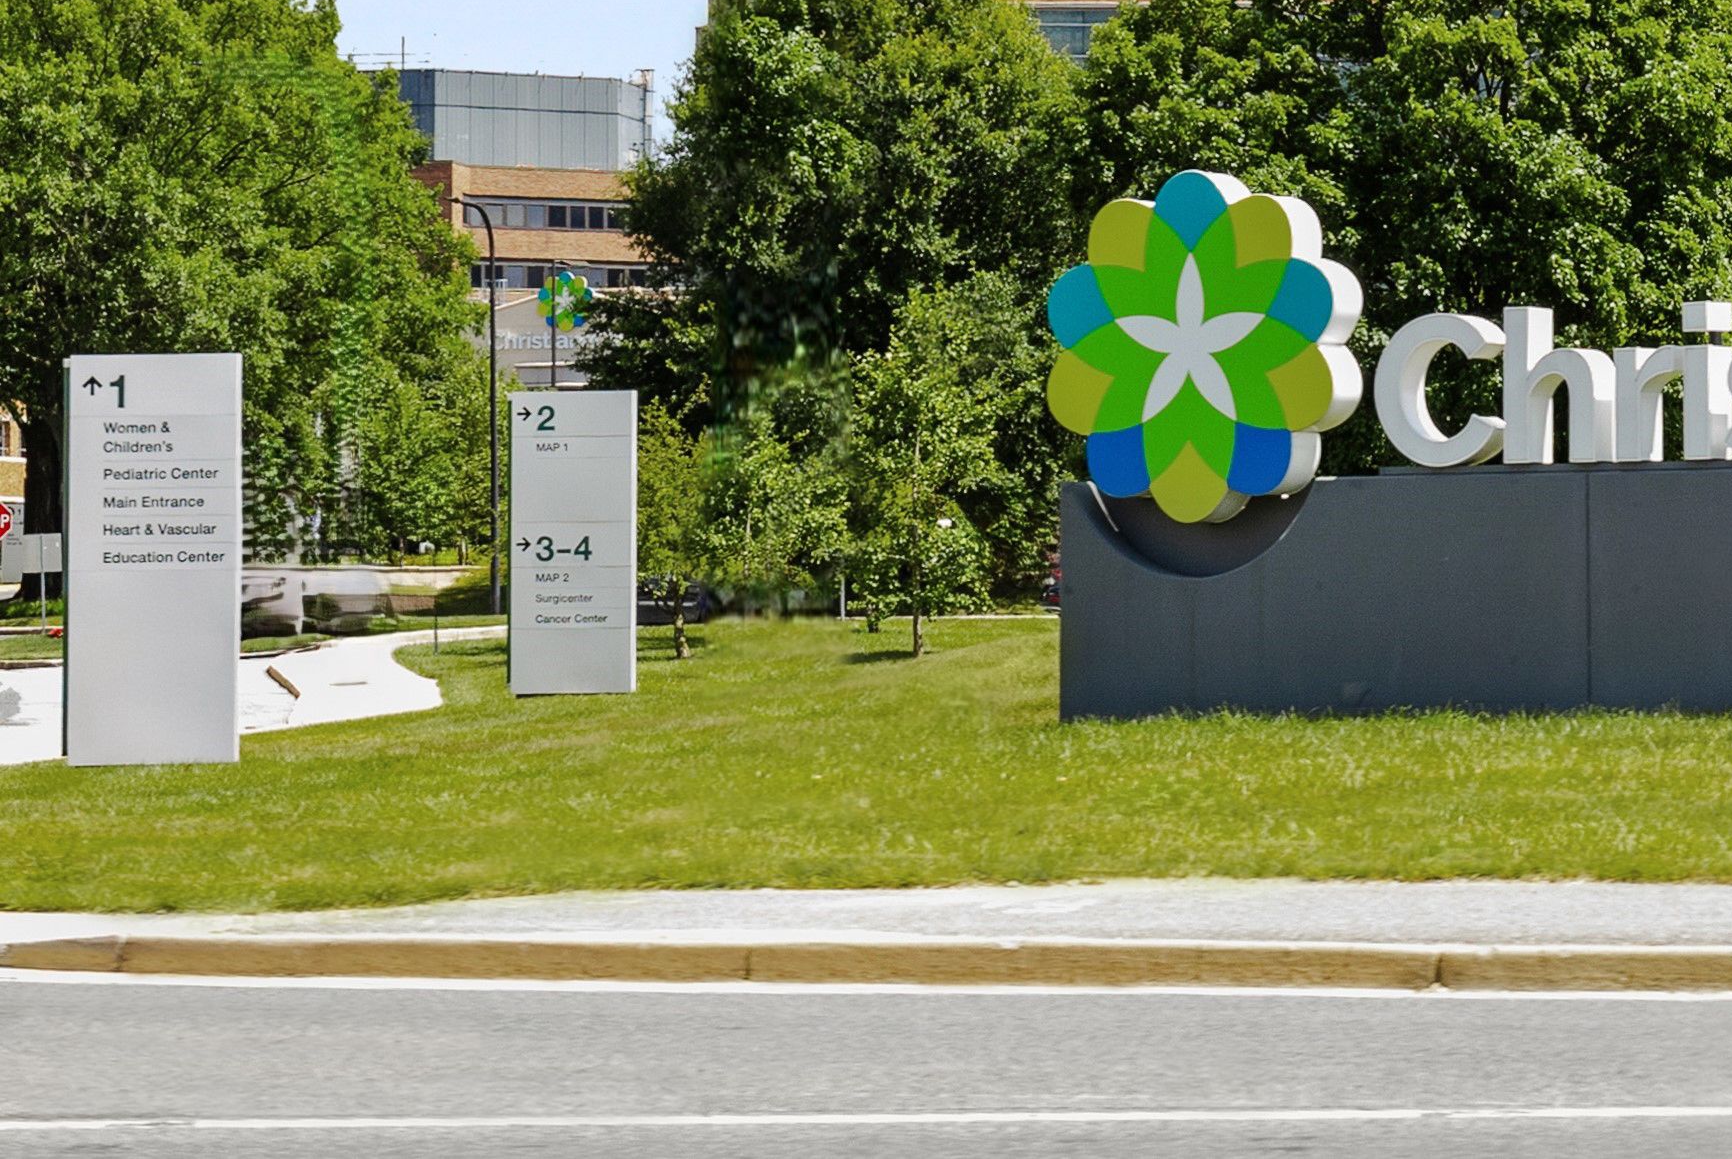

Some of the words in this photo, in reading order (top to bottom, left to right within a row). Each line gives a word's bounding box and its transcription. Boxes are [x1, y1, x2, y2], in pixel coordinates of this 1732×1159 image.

[109, 374, 125, 408] 1
[537, 405, 555, 431] 2
[103, 422, 156, 433] Women
[161, 421, 171, 433] &
[103, 441, 173, 453] Children's
[536, 443, 560, 452] MAP
[563, 443, 569, 452] 1
[103, 467, 167, 480] Pediatric
[171, 466, 219, 479] Center
[103, 496, 137, 508] Main
[141, 495, 205, 508] Entrance
[103, 524, 140, 536] Heart
[144, 523, 154, 535] &
[158, 522, 217, 535] Vascular
[103, 550, 173, 563] Education
[177, 550, 225, 563] Center
[535, 573, 560, 582] MAP
[563, 573, 570, 582] 2
[535, 594, 593, 605] Surgicenter
[535, 614, 571, 623] Cancer
[574, 613, 608, 623] Center
